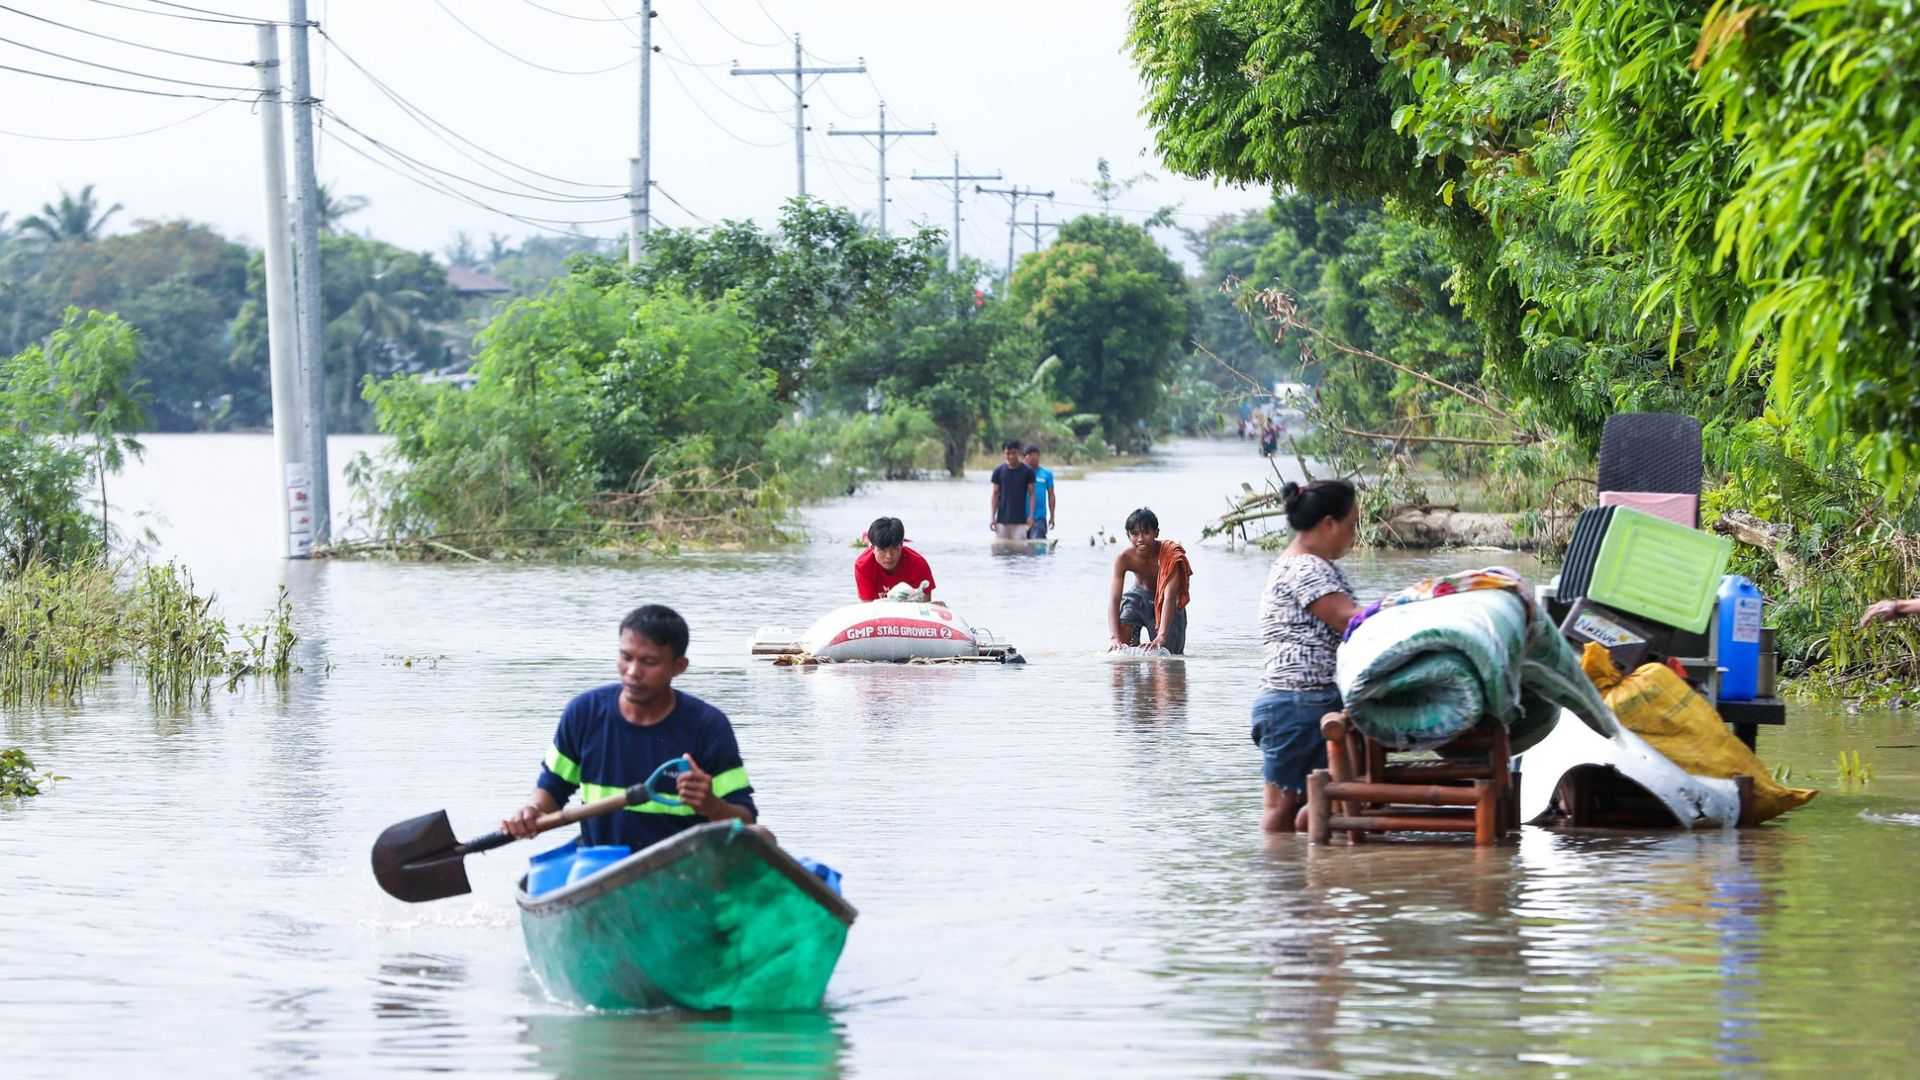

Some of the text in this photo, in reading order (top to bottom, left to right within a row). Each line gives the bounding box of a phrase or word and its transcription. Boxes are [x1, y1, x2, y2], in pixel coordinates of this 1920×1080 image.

[847, 626, 875, 639] GMP
[877, 625, 899, 636] STAG
[900, 627, 937, 637] GROWER
